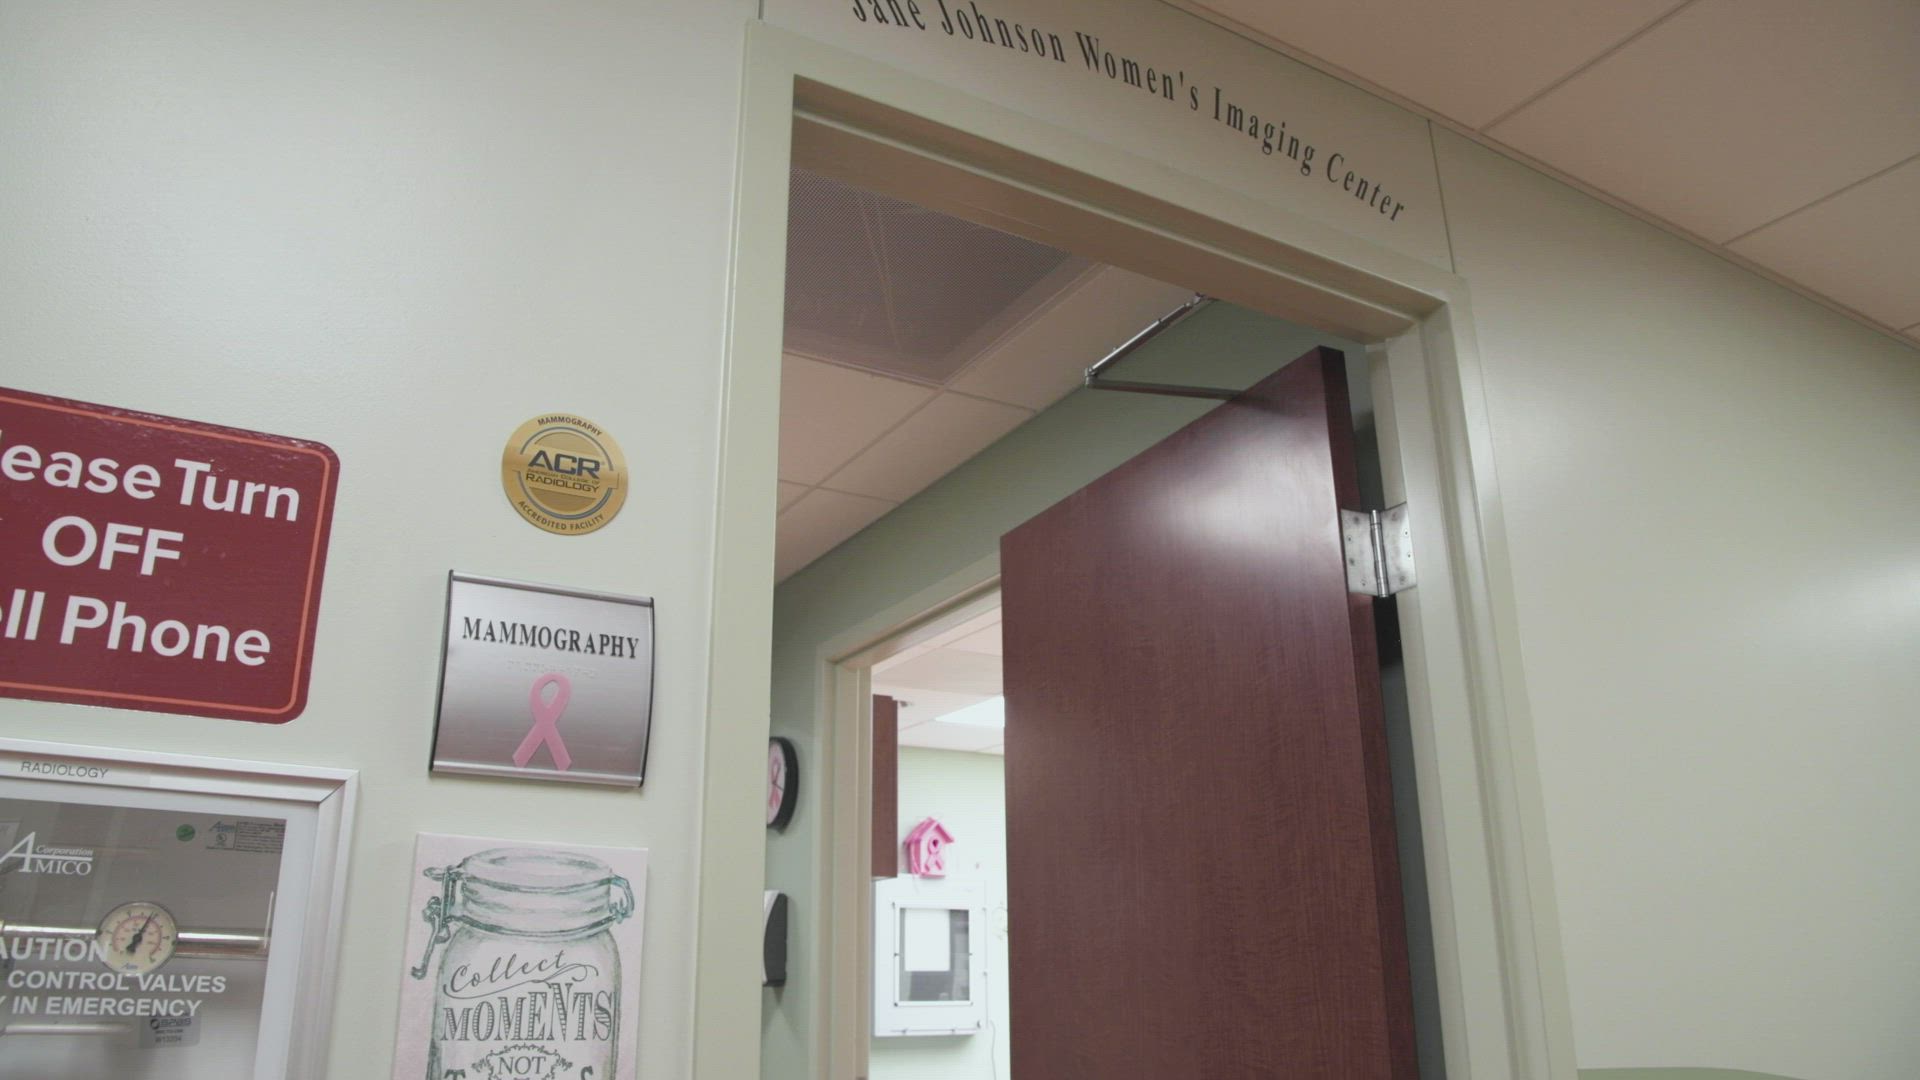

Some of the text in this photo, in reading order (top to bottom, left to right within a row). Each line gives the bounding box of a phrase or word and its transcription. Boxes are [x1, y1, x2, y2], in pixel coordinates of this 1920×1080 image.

[936, 0, 1066, 63] Johnson
[1076, 31, 1200, 111] Women's
[1213, 87, 1316, 176] Imaging
[1326, 153, 1405, 223] Center
[537, 416, 603, 436] MAMMOGRAPHY
[528, 450, 600, 480] ACR
[174, 459, 300, 522] Turn
[526, 473, 600, 493] RADIOLOGY
[518, 500, 604, 531] ACCREDITED FACILITY
[42, 515, 184, 576] OFF
[59, 595, 271, 666] Phone
[462, 616, 639, 659] MAMMOGRAPHY
[20, 761, 109, 779] RADIOLOGY
[7, 970, 227, 993] CONTROL VALVES
[449, 950, 567, 993] Collect
[12, 995, 38, 1015] IN
[45, 996, 202, 1017] EMERGENCY
[440, 982, 614, 1042] MOMENTS
[498, 1056, 547, 1075] NOT
